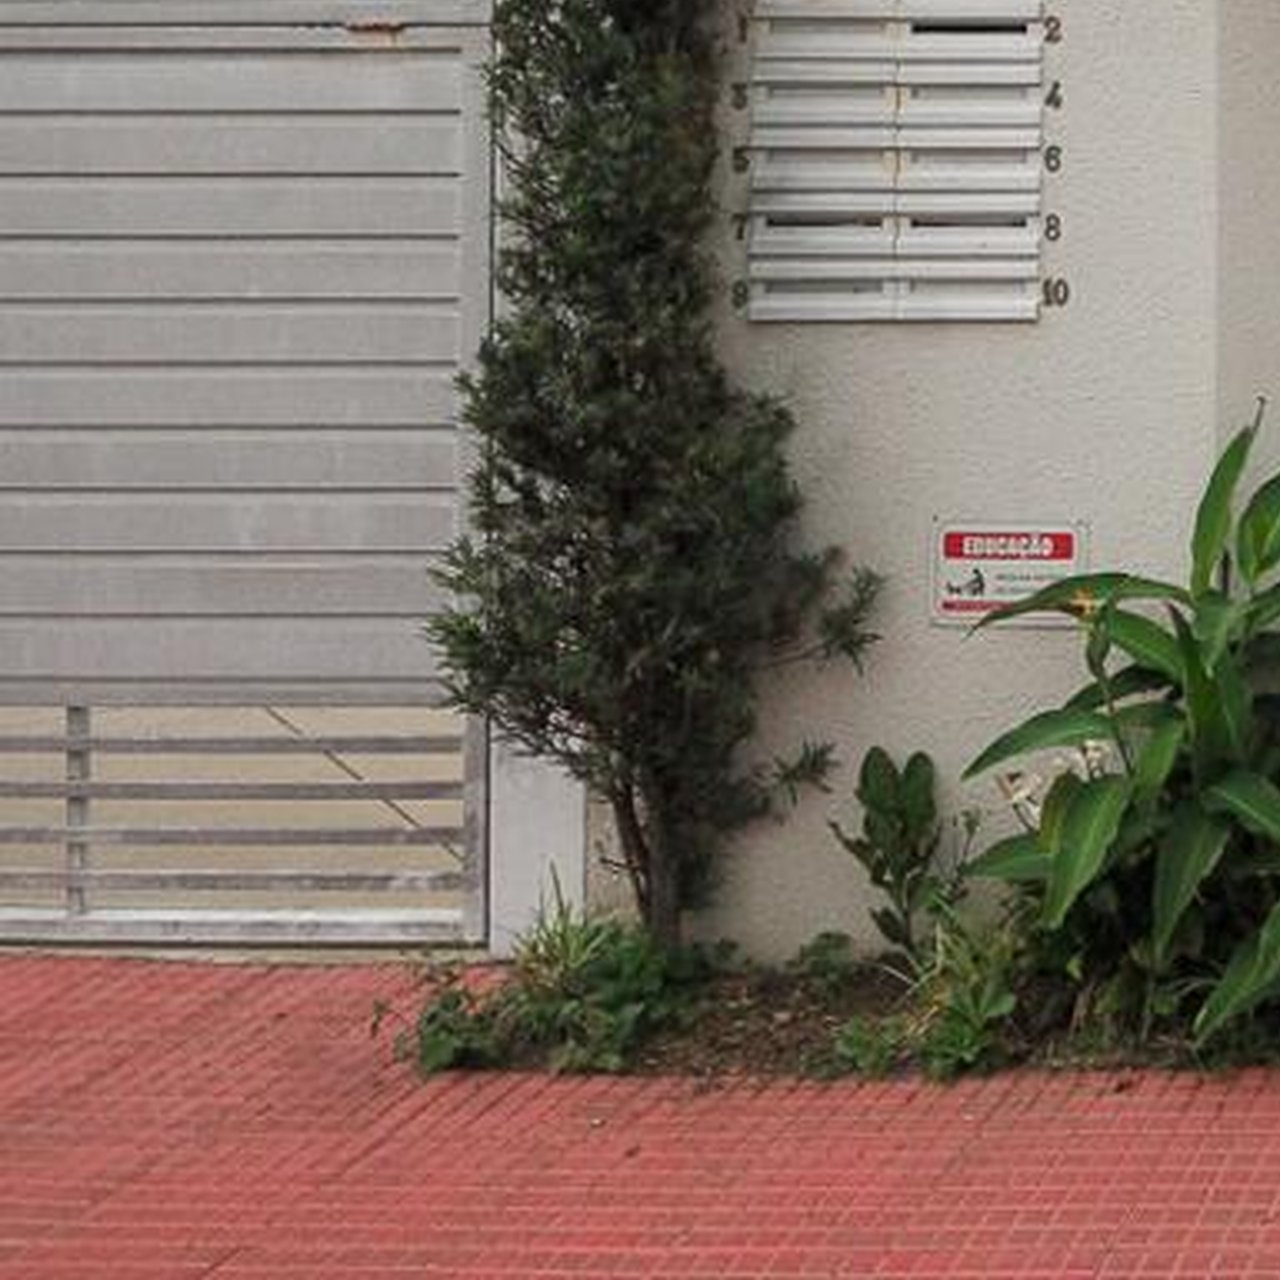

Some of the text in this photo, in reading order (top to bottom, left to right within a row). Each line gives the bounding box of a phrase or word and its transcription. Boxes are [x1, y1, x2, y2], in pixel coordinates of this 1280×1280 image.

[1044, 16, 1061, 43] 2
[731, 82, 748, 110] 3
[1044, 81, 1061, 109] 4
[732, 147, 749, 173] 5
[1044, 146, 1061, 173] 6
[731, 213, 748, 241] 7
[1044, 213, 1061, 241] 8
[732, 280, 748, 308] 9
[1043, 278, 1070, 308] 10
